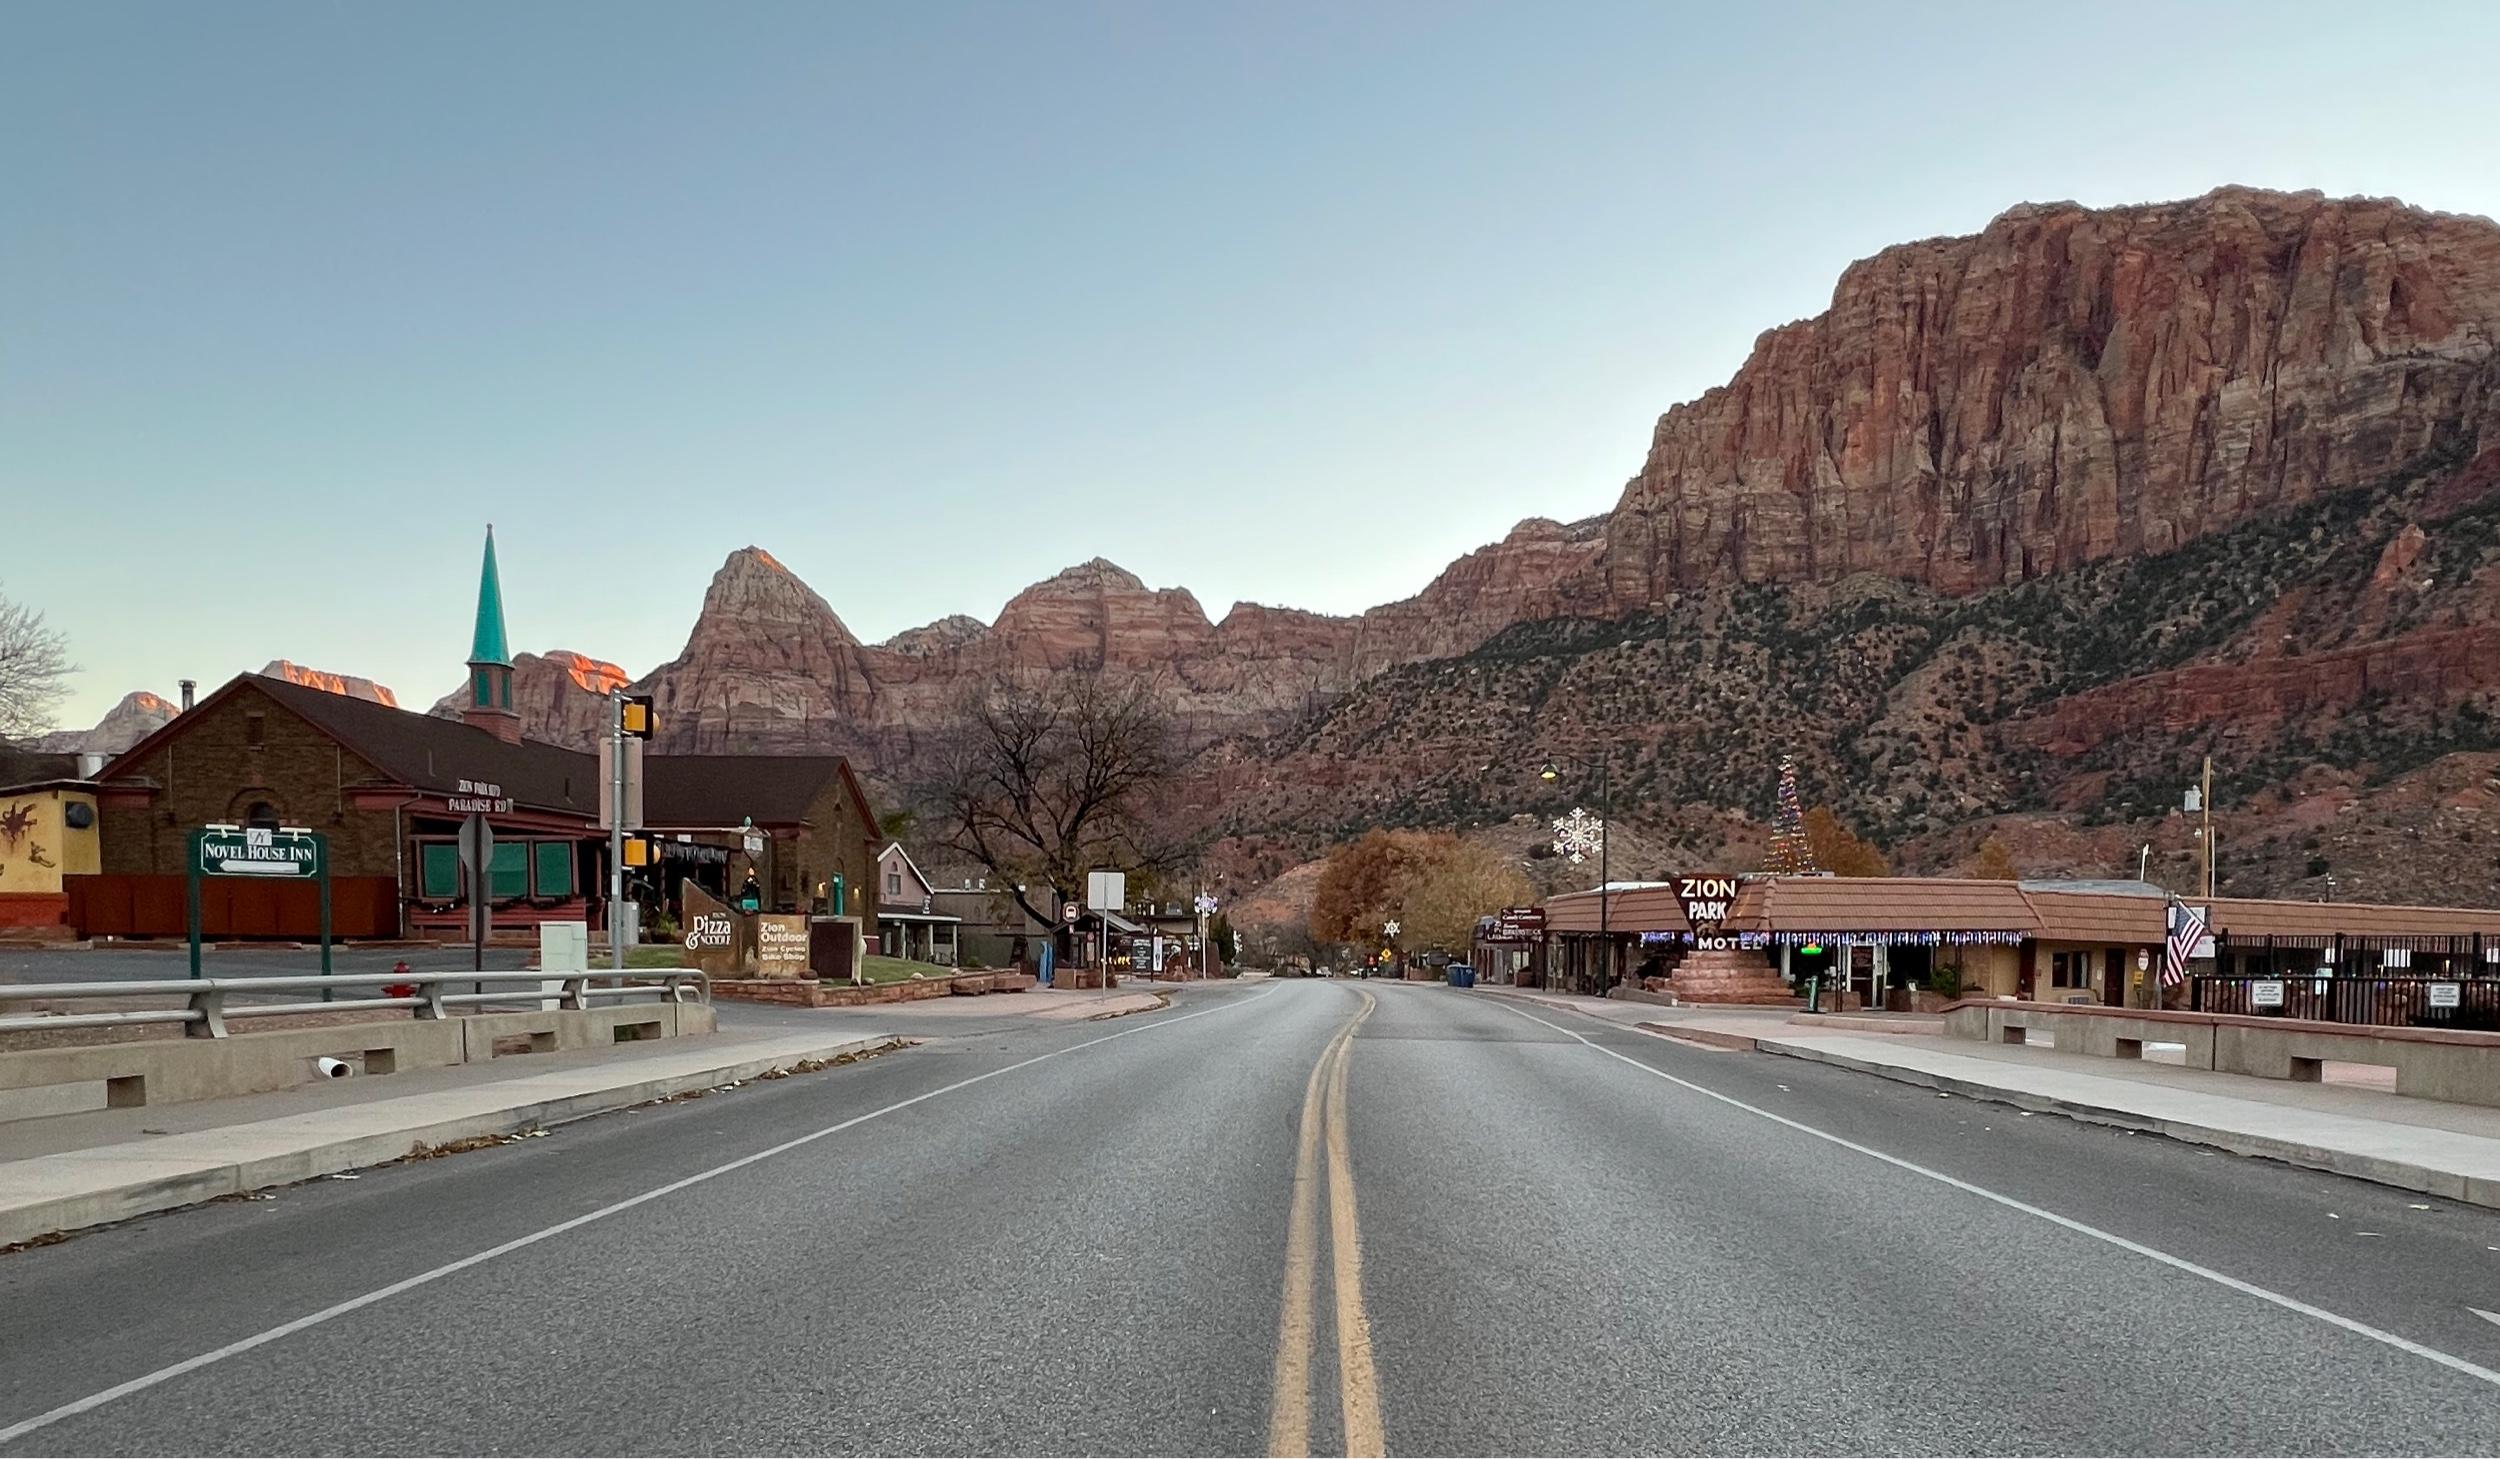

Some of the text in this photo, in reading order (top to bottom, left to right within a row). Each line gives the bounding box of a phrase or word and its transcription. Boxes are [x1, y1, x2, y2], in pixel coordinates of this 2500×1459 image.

[448, 798, 491, 812] PARADISE
[205, 843, 312, 861] NOVEL HOUSE INN
[1680, 879, 1736, 898] ZION
[1689, 901, 1727, 920] PARK
[693, 915, 731, 935] Pizza
[760, 922, 786, 933] Zion
[685, 932, 701, 950] &
[760, 932, 808, 943] Outdoor
[1698, 937, 1763, 950] MOTEL
